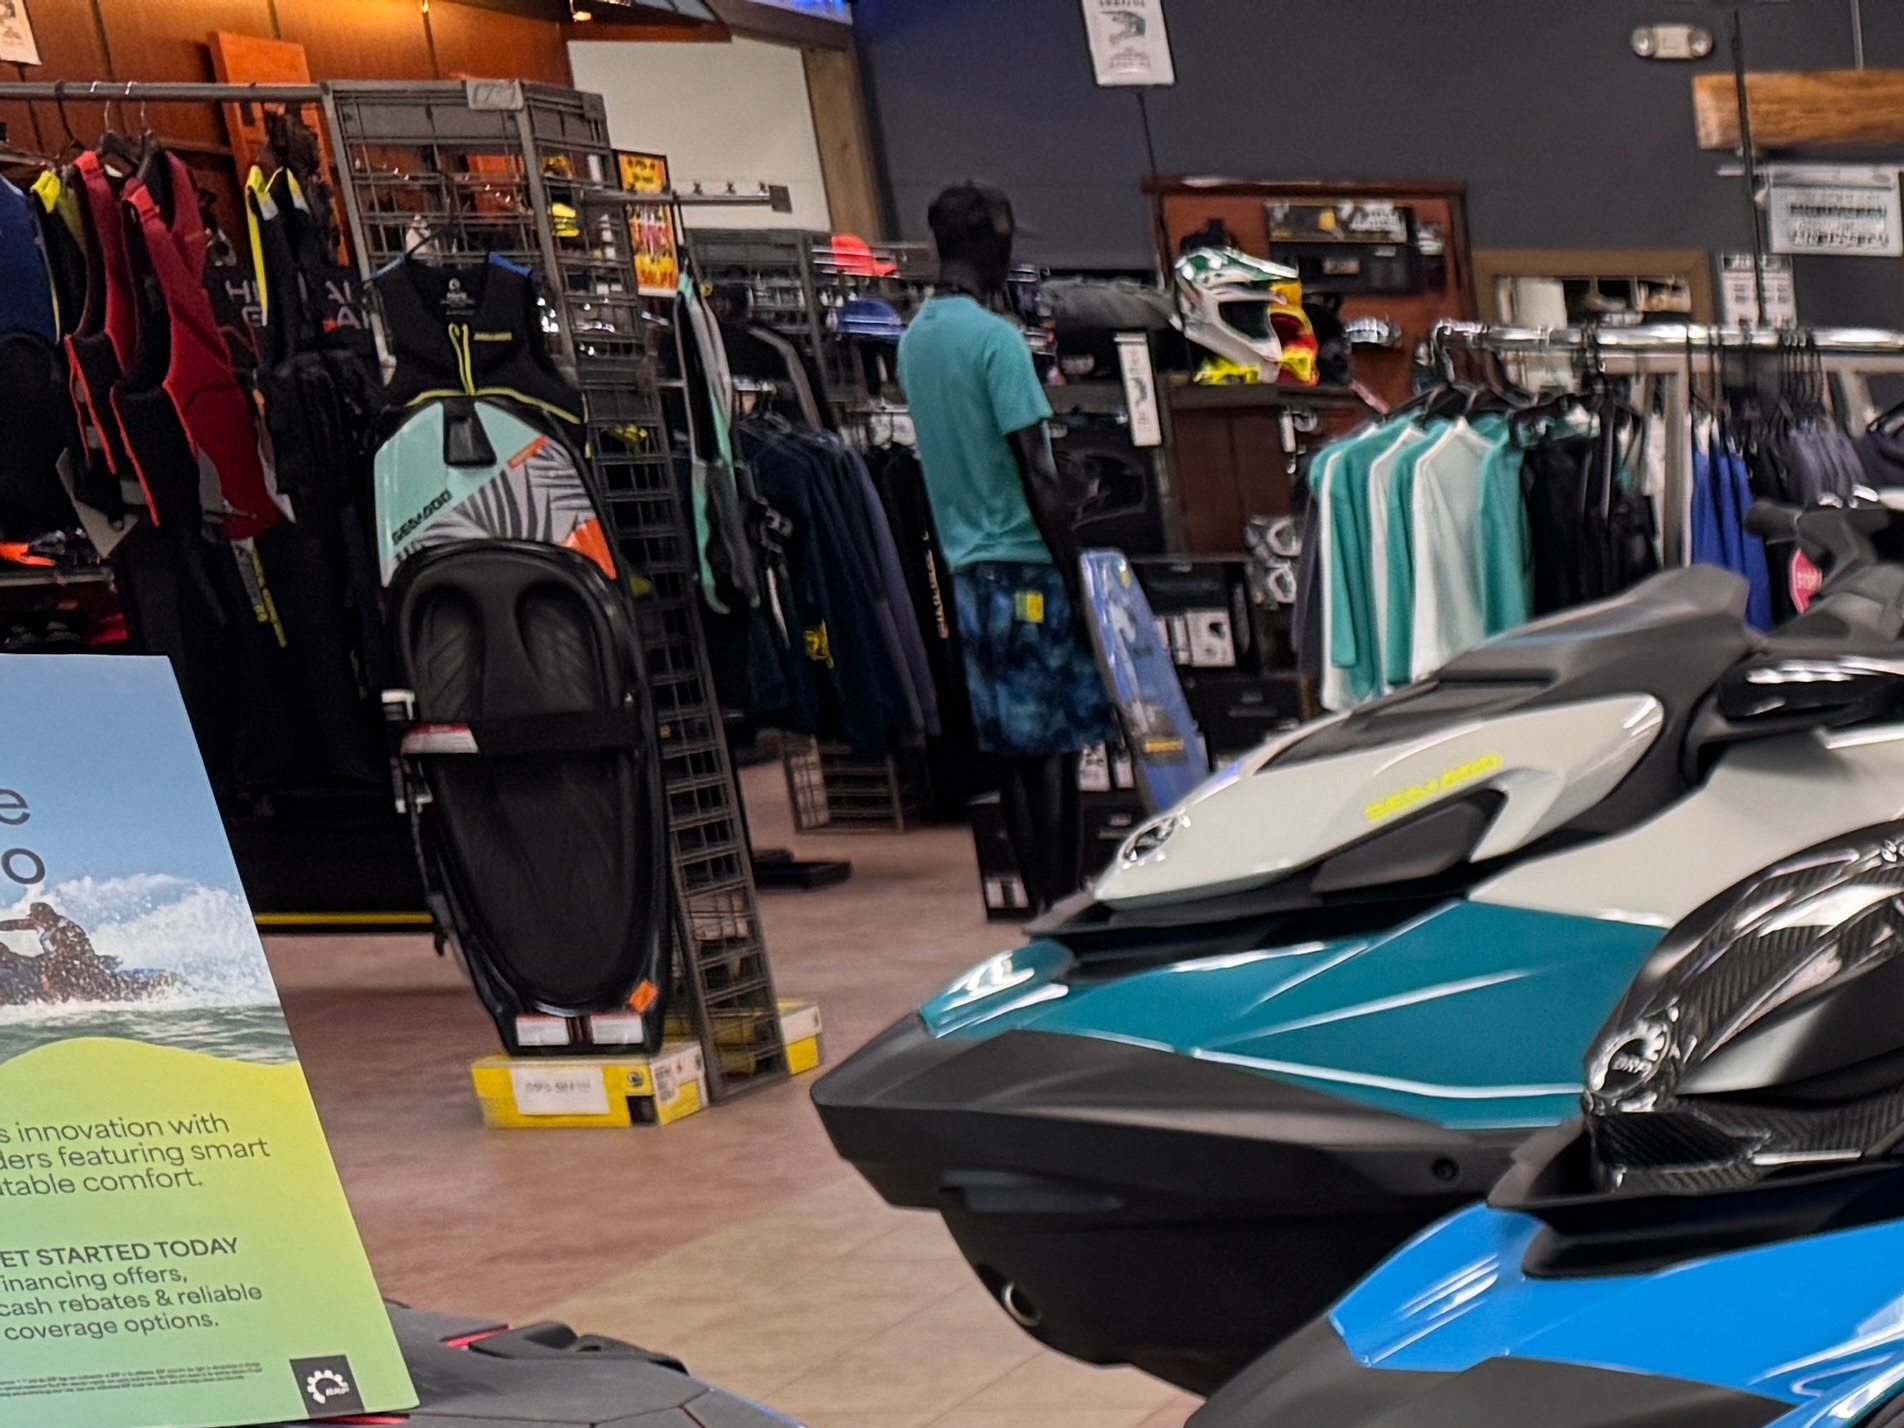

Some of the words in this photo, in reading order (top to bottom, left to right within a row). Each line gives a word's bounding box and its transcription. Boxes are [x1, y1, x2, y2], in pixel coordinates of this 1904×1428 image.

[16, 1117, 164, 1143] innovation
[168, 1113, 230, 1135] with
[0, 1149, 53, 1171] ers
[58, 1142, 185, 1168] featuring
[191, 1138, 271, 1161] smart
[0, 1173, 76, 1197] table
[83, 1168, 203, 1193] comfort.
[0, 1250, 30, 1268] ET
[36, 1242, 150, 1266] STARTED
[154, 1237, 238, 1259] TODAY
[0, 1270, 107, 1293] inancing
[113, 1266, 188, 1286] offers,
[59, 1293, 151, 1313] rebates
[155, 1289, 173, 1307] &
[178, 1283, 262, 1306] reliable
[4, 1320, 119, 1341] coverage
[124, 1312, 220, 1336] options.
